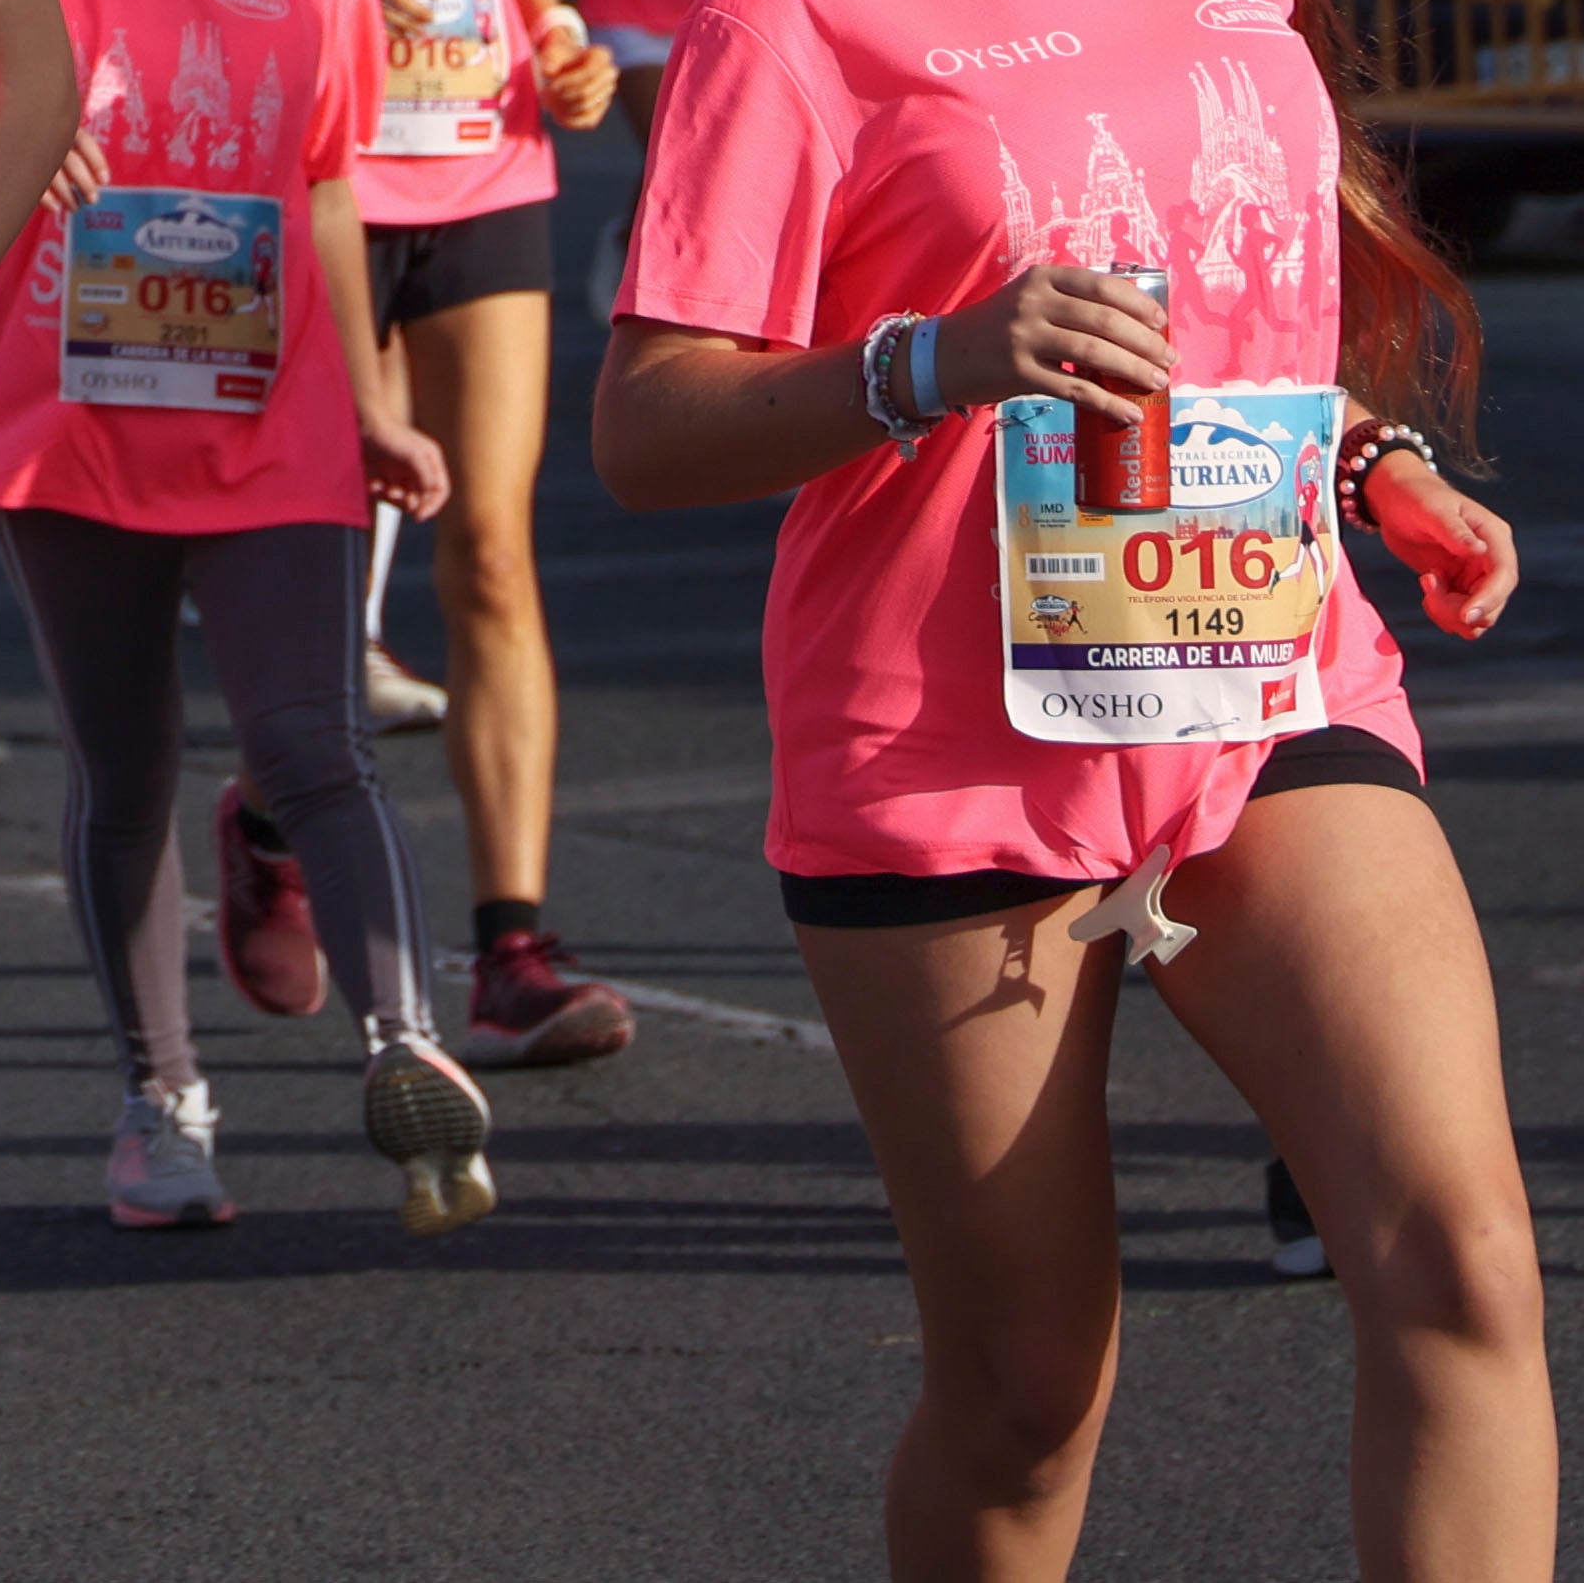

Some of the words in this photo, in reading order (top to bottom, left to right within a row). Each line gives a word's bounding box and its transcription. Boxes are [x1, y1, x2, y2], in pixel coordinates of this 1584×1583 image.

[388, 36, 467, 70] 016
[926, 31, 1083, 76] OYSHO
[137, 273, 233, 318] 016
[1023, 433, 1039, 444] TU
[1042, 432, 1076, 444] DORS
[1119, 424, 1142, 456] Bu
[1024, 446, 1076, 465] SUM
[1119, 459, 1142, 504] Red
[1169, 463, 1274, 487] TURIANA
[1040, 503, 1065, 514] IMD
[1122, 528, 1277, 593] 016
[1177, 594, 1226, 603] VIOLENCIA
[1226, 594, 1239, 602] DE
[1164, 607, 1245, 637] 1149
[1087, 645, 1181, 668] CARRERA
[1185, 645, 1213, 666] DE
[1218, 644, 1245, 665] LA
[1249, 642, 1295, 665] MUJER
[1041, 692, 1164, 719] OYSHO
